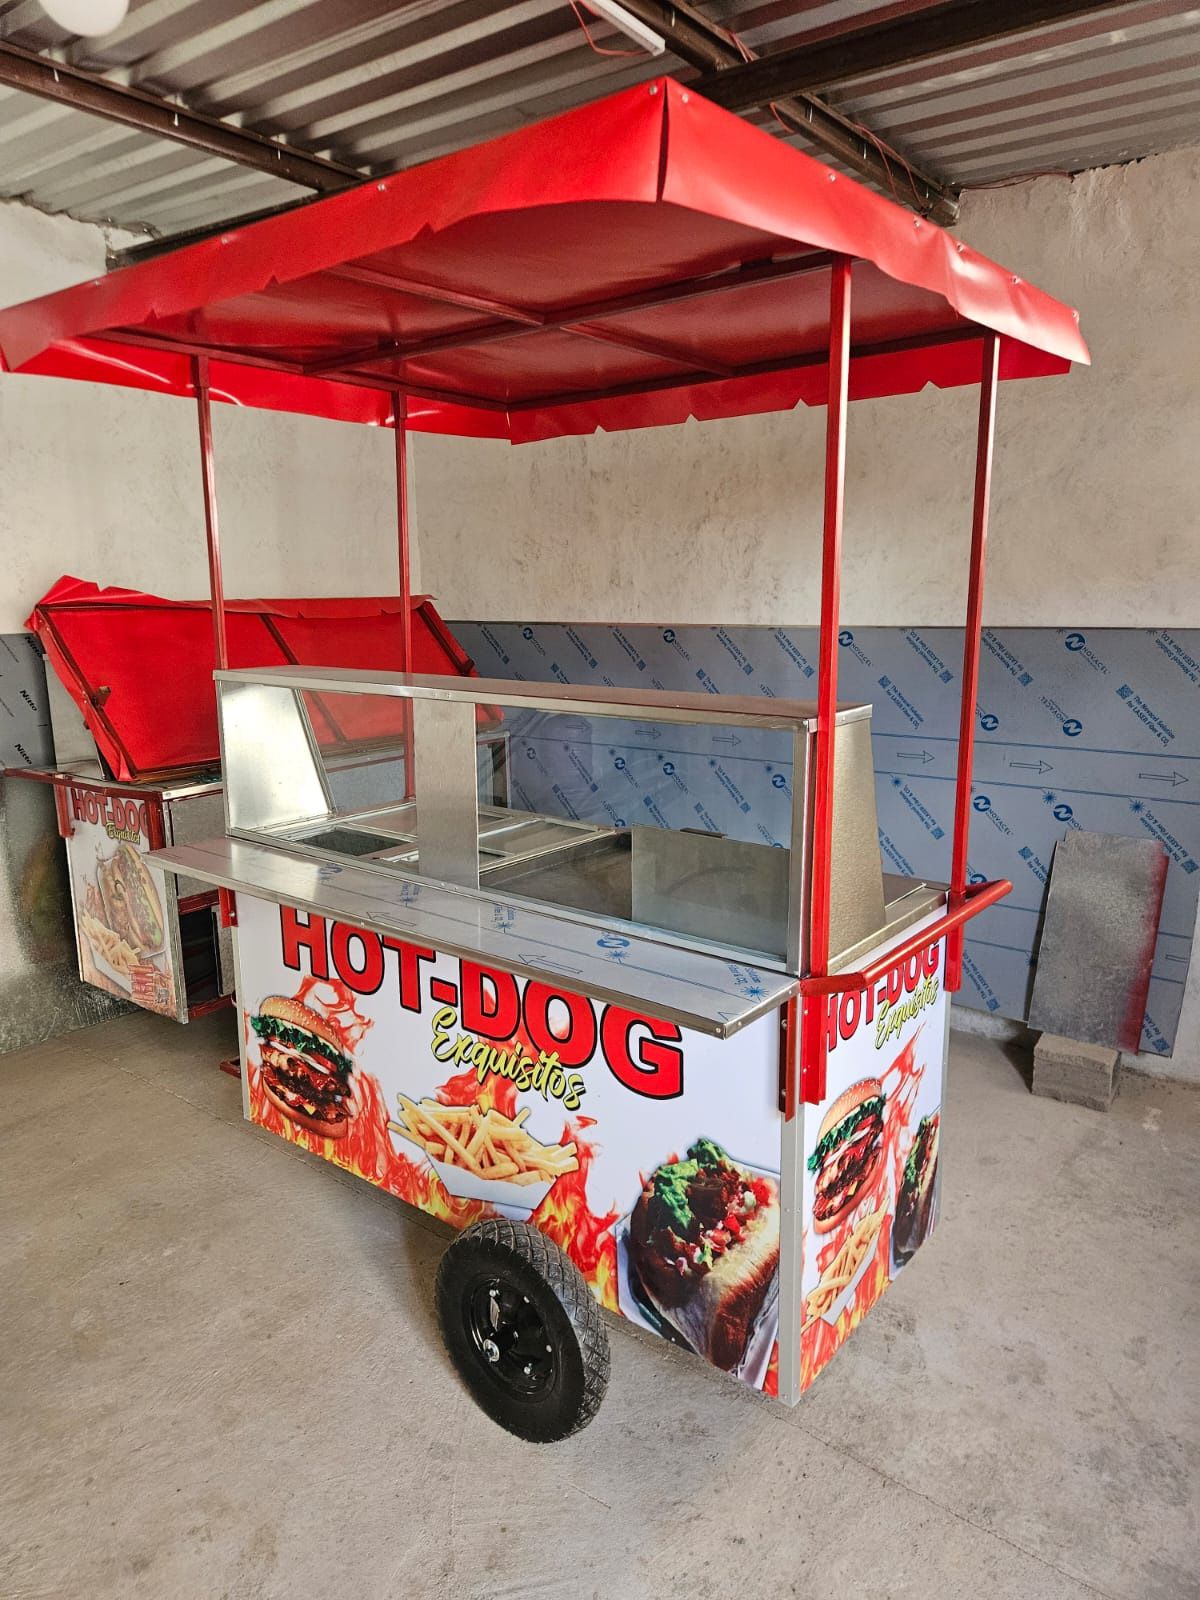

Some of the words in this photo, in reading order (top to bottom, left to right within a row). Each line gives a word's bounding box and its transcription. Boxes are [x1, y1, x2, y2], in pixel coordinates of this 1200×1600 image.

[1082, 647, 1108, 674] NOVACEL
[20, 689, 38, 711] Nitto
[1040, 696, 1066, 723] NOVACEL
[14, 743, 33, 765] Nitto
[278, 903, 685, 1101] HOT-DOG
[824, 942, 941, 1053] HOT-DOG
[874, 974, 940, 1050] Exquisitos
[430, 1006, 587, 1110] Exquisitos
